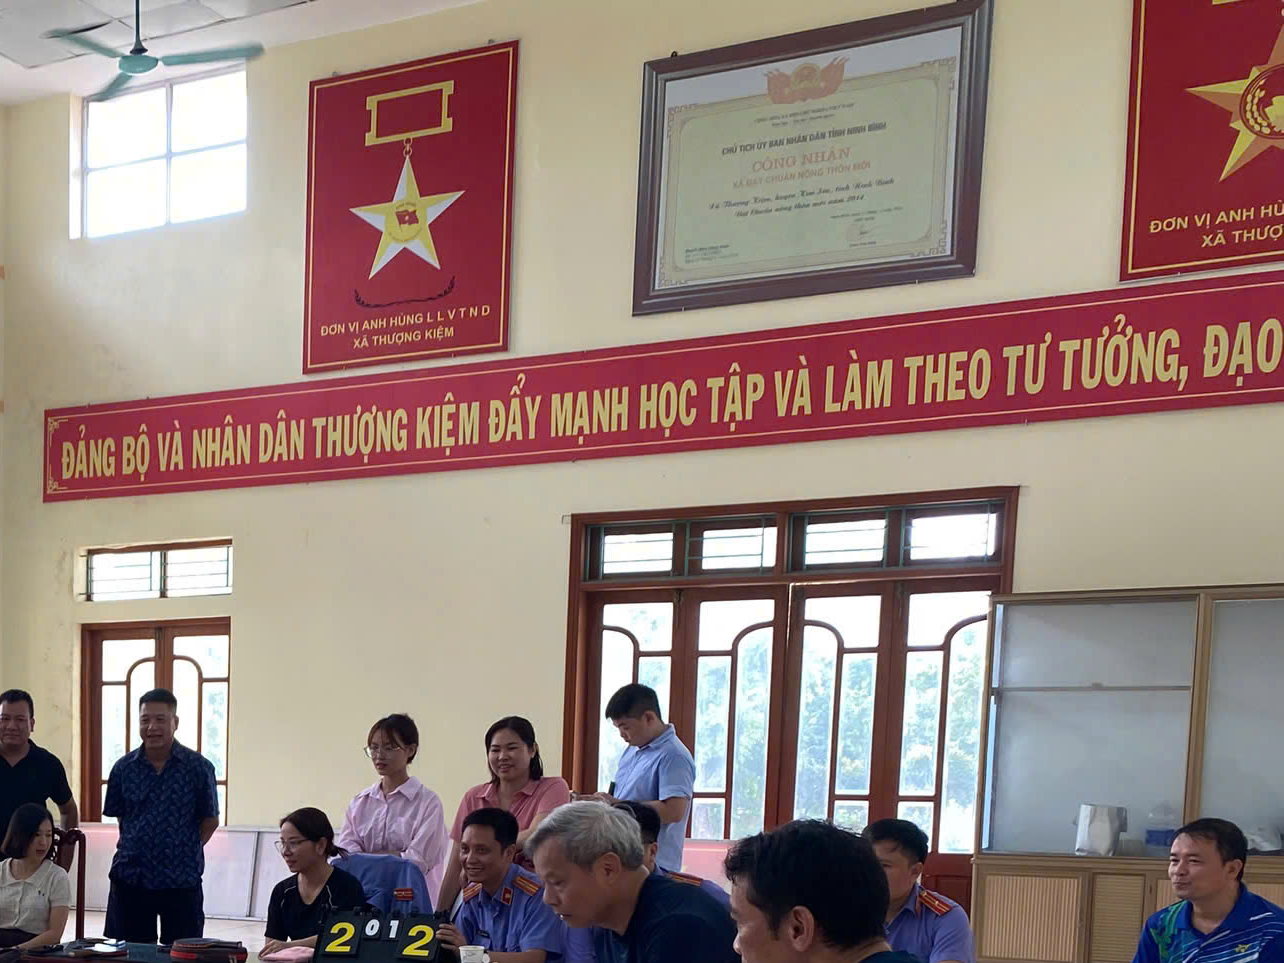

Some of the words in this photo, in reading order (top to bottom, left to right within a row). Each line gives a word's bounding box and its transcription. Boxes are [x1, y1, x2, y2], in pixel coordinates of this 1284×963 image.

[769, 138, 784, 148] BAN
[846, 126, 866, 136] NINH
[752, 155, 797, 172] CÔNG
[1149, 215, 1188, 234] ĐƠN
[1194, 213, 1210, 229] VỊ
[1215, 207, 1255, 224] ANH
[1202, 230, 1226, 248] XÃ
[320, 323, 345, 336] ĐƠN
[348, 321, 359, 334] VỊ
[362, 318, 387, 331] ANH
[390, 312, 424, 328] HÙNG
[354, 334, 369, 349] XÃ
[372, 330, 422, 346] THƯỢNG
[424, 325, 454, 341] KIỆM
[62, 424, 116, 480] ĐẢNG
[122, 424, 150, 482] BỘ
[157, 420, 184, 472] VÀ
[192, 414, 252, 469] NHÂN
[258, 409, 305, 464] DÂN
[312, 405, 408, 464] THƯỢNG
[416, 392, 480, 456] KIỆM
[488, 372, 542, 444] ĐẨY
[550, 386, 629, 444] MẠNH
[639, 379, 698, 438] HỌC
[706, 362, 765, 432] TẬP
[774, 355, 812, 417] VÀ
[824, 350, 894, 414] LÀM
[904, 348, 992, 406] THEO
[1002, 332, 1052, 396] TƯ
[1058, 313, 1189, 392] TƯỞNG,
[1202, 318, 1284, 387] ĐẠO
[324, 922, 356, 952] 2
[365, 919, 380, 936] 0
[388, 920, 400, 938] 1
[402, 924, 434, 956] 2
